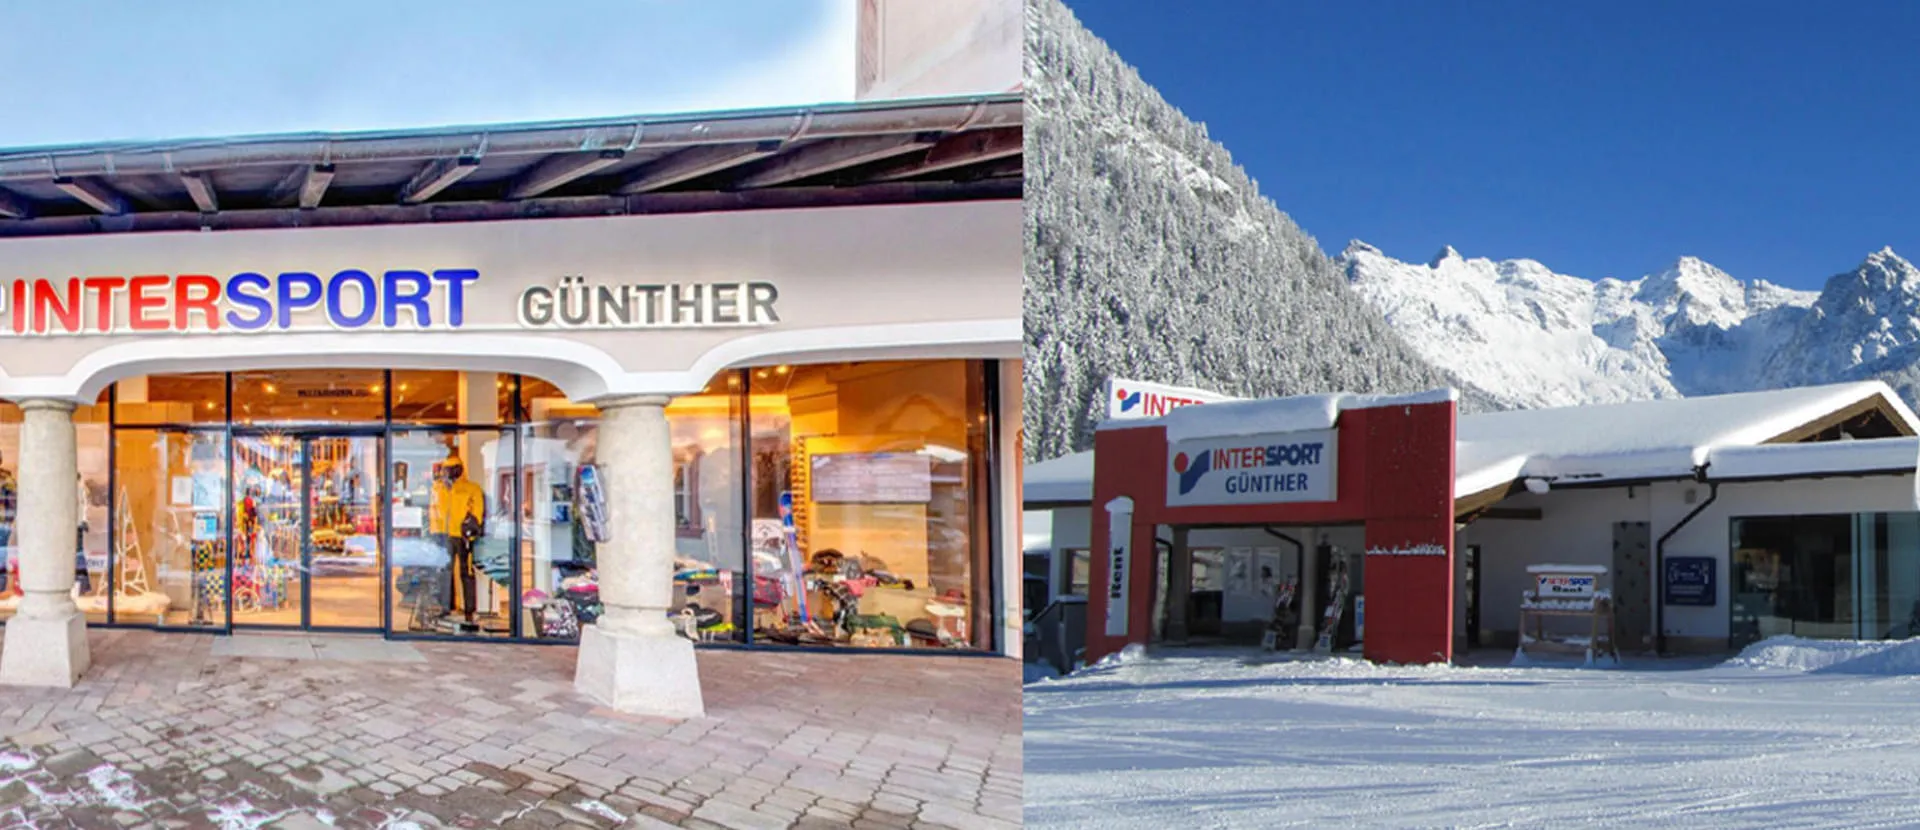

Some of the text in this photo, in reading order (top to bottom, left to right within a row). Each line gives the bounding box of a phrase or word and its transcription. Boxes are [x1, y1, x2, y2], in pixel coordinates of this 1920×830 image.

[12, 268, 780, 333] INTERSPORT GÜNTHER
[1213, 443, 1324, 470] INTERSPORT
[1225, 471, 1309, 494] GÜNTHER
[1111, 546, 1124, 598] Rent
